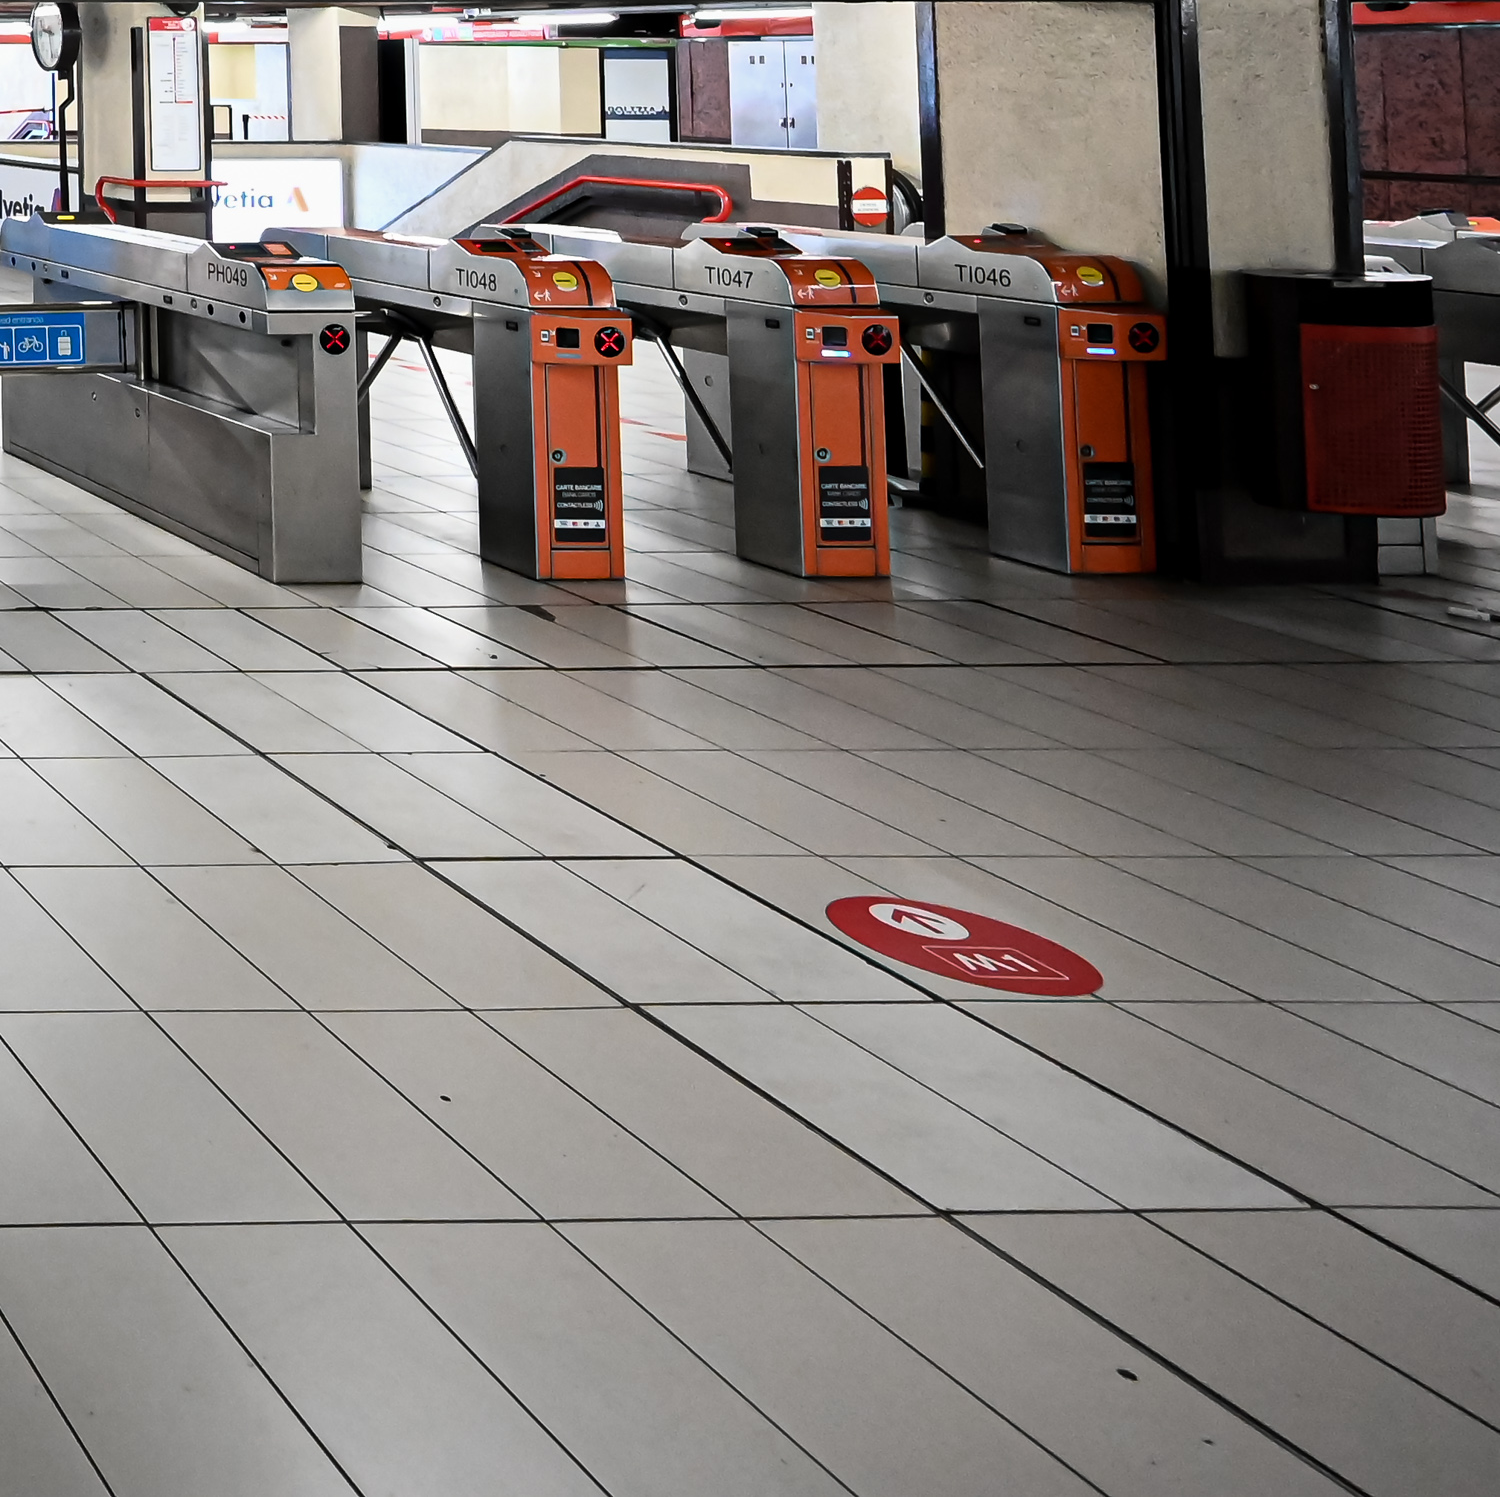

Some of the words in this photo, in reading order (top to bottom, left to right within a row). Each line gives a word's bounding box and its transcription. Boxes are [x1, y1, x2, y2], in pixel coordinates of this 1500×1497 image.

[607, 106, 657, 115] POLIZIA
[206, 262, 248, 288] PH049
[953, 952, 1039, 973] M1
